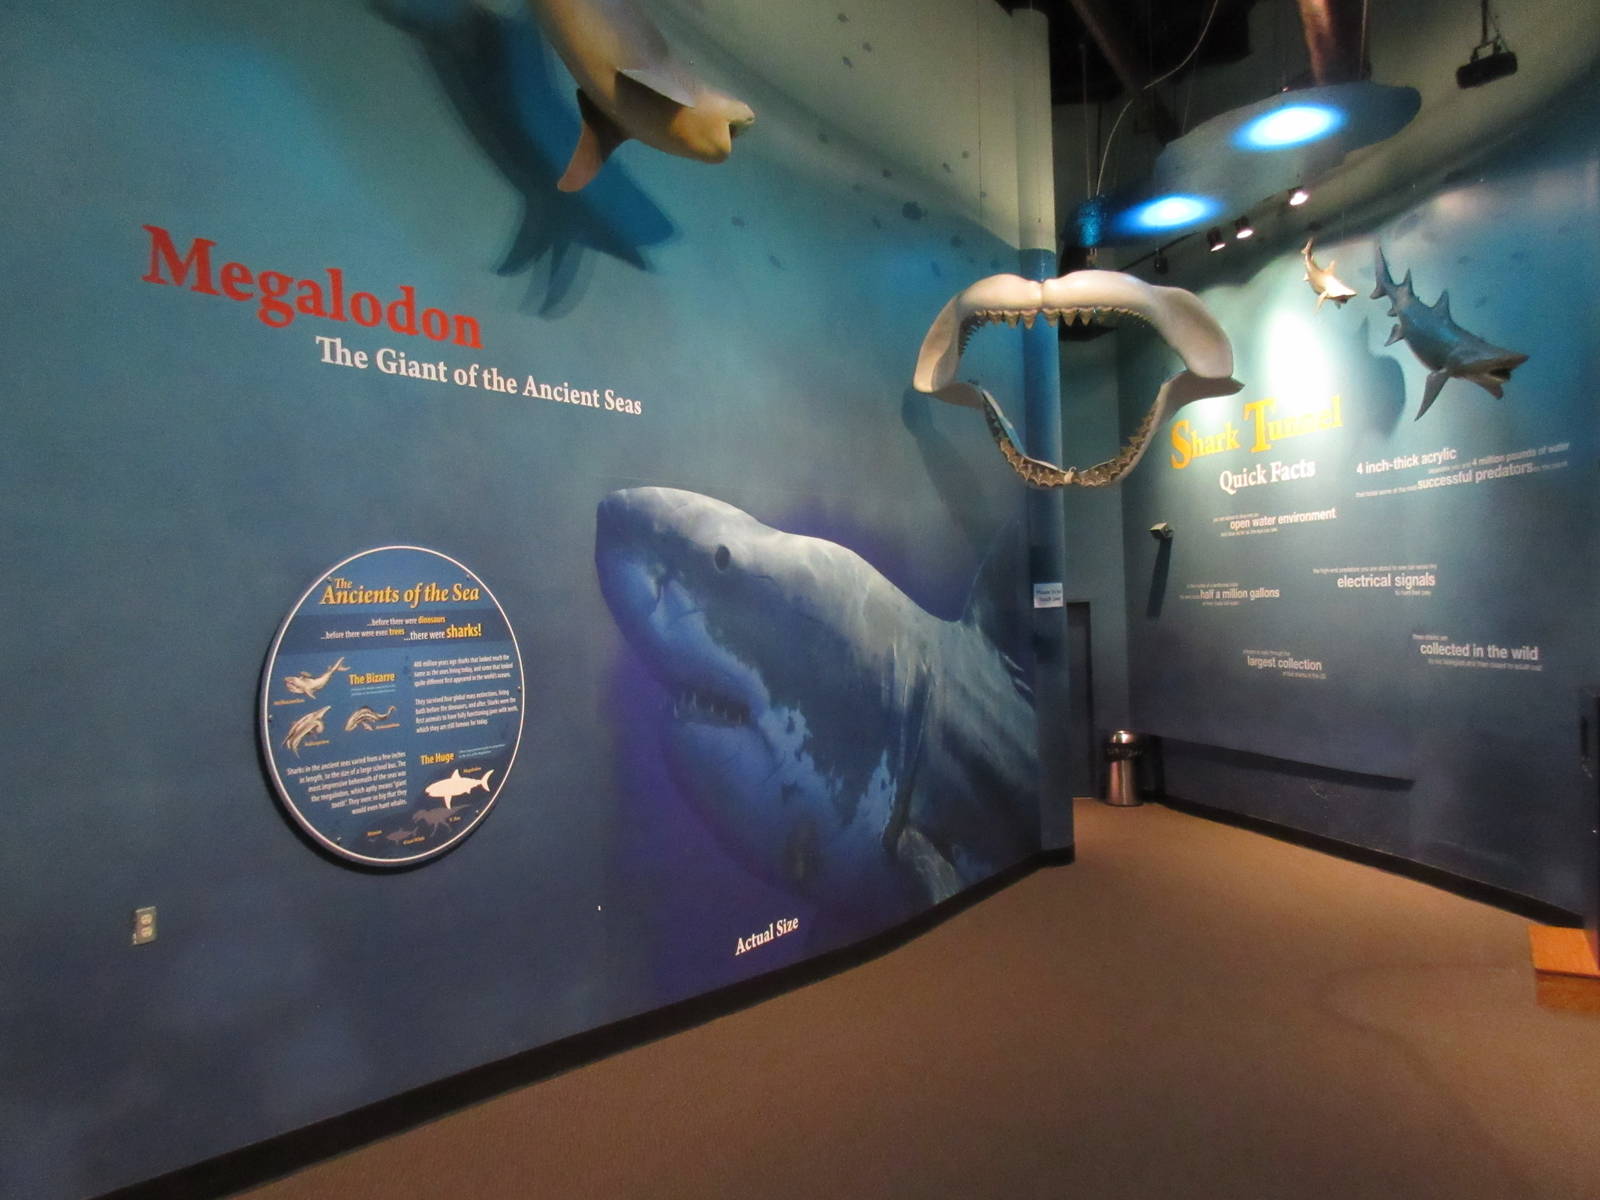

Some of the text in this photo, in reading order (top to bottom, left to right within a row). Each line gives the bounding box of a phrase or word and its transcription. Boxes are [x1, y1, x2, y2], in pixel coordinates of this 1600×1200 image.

[142, 224, 485, 349] Megalodon
[316, 335, 642, 415] The Giant of the Ancient Seas
[1170, 395, 1344, 469] Shark Tunnel
[1356, 462, 1363, 474] 4
[1365, 453, 1419, 474] inch-thick
[1422, 447, 1457, 465] acrylic
[1219, 459, 1316, 495] Quick Facts
[1417, 469, 1473, 490] successful
[1475, 462, 1534, 484] predators
[1230, 519, 1250, 531] open
[1252, 516, 1276, 526] water
[1278, 508, 1337, 525] environment
[335, 578, 352, 589] The
[1337, 571, 1436, 590] electrical signals
[320, 582, 480, 608] Ancients of the Sea
[1222, 588, 1248, 599] million
[1250, 587, 1280, 601] gallons
[405, 617, 417, 625] were
[418, 616, 446, 624] dinosaurs
[389, 628, 405, 636] trees
[429, 632, 445, 640] were
[446, 623, 482, 639] sharks!
[1420, 642, 1539, 660] collected in the wild
[1247, 655, 1322, 671] largest collection
[349, 672, 396, 685] The Bizarre
[420, 755, 435, 765] The
[435, 752, 455, 764] Huge
[735, 918, 799, 956] Actual Size
